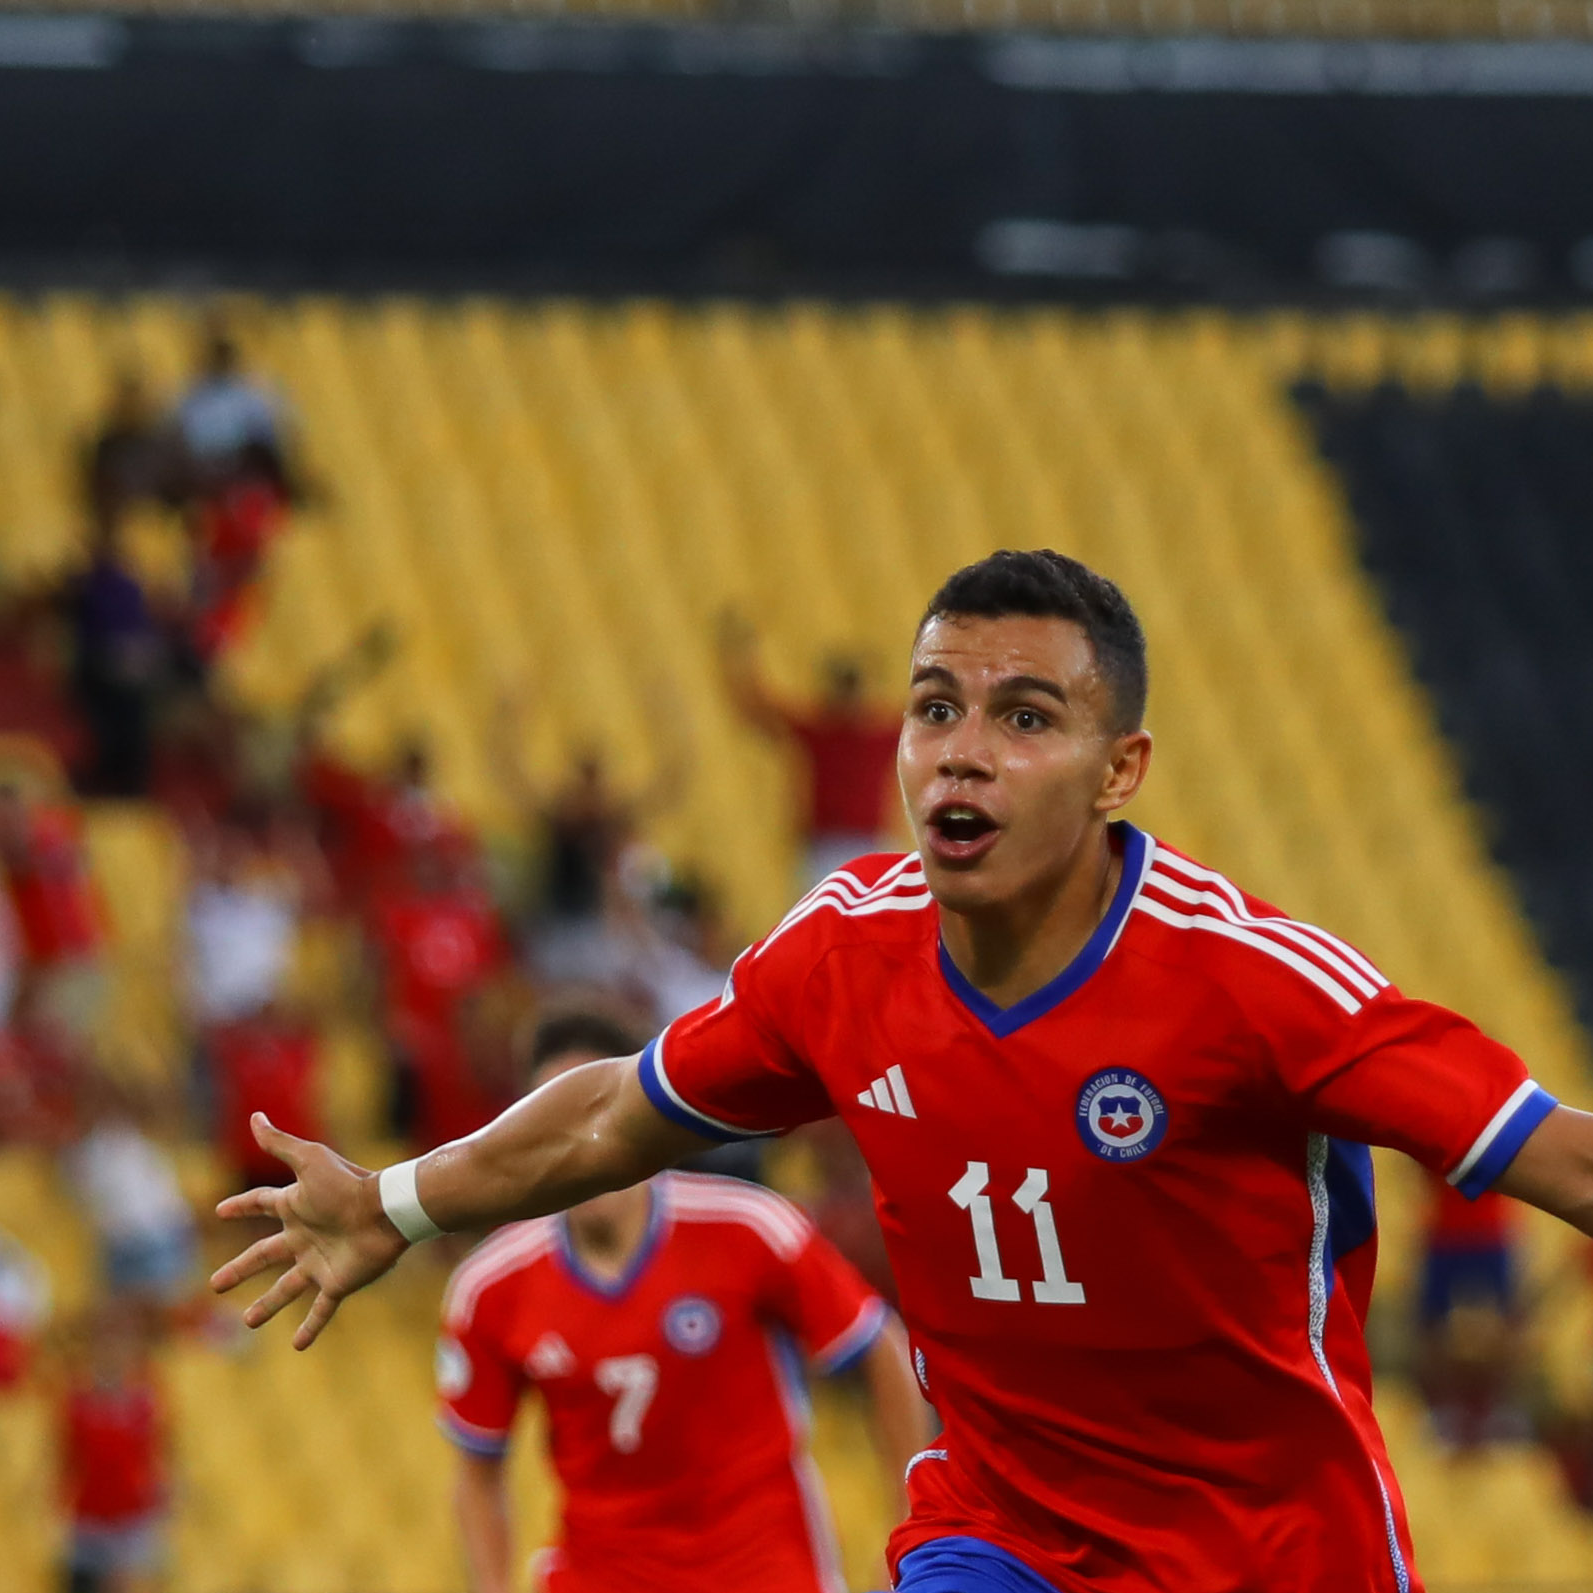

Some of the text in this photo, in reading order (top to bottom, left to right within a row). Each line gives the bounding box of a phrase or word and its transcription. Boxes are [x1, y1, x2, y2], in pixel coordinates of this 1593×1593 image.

[1079, 1073, 1118, 1117] FEDERACION
[1125, 1074, 1138, 1086] DE
[1100, 1142, 1148, 1158] DE CHILE
[946, 1160, 1087, 1305] 11
[595, 1353, 659, 1455] 7
